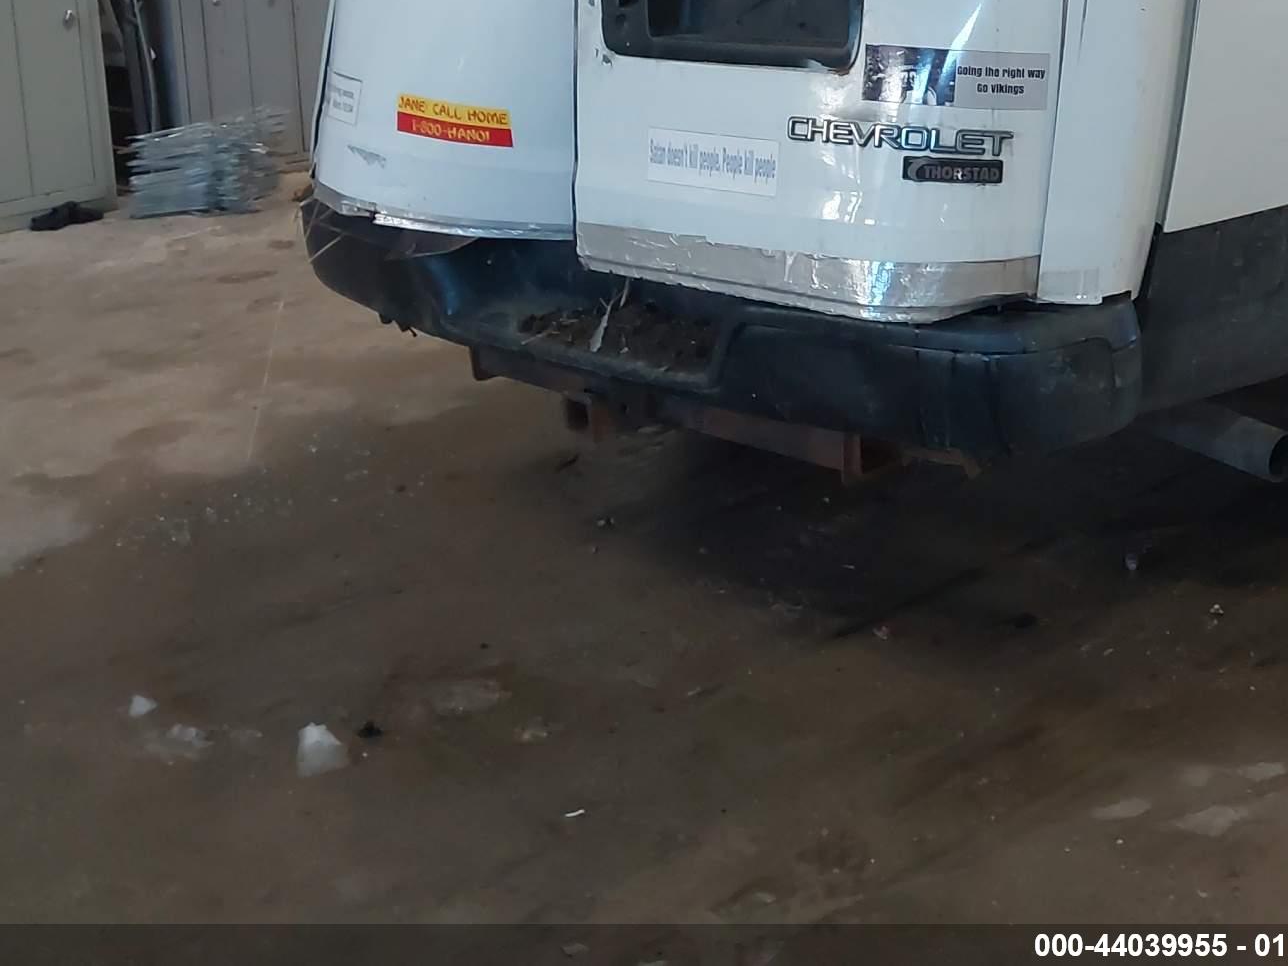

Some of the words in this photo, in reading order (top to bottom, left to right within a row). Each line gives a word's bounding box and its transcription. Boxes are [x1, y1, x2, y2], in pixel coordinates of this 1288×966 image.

[957, 65, 982, 79] Going
[1002, 66, 1025, 79] right
[1027, 69, 1046, 80] way
[976, 84, 988, 94] Go
[990, 84, 1025, 95] Vikings
[399, 96, 424, 113] JANE
[432, 104, 461, 119] CALL
[467, 110, 508, 124] HOME
[787, 116, 1014, 156] CHEVROLET
[922, 165, 1000, 182] THORSTAD
